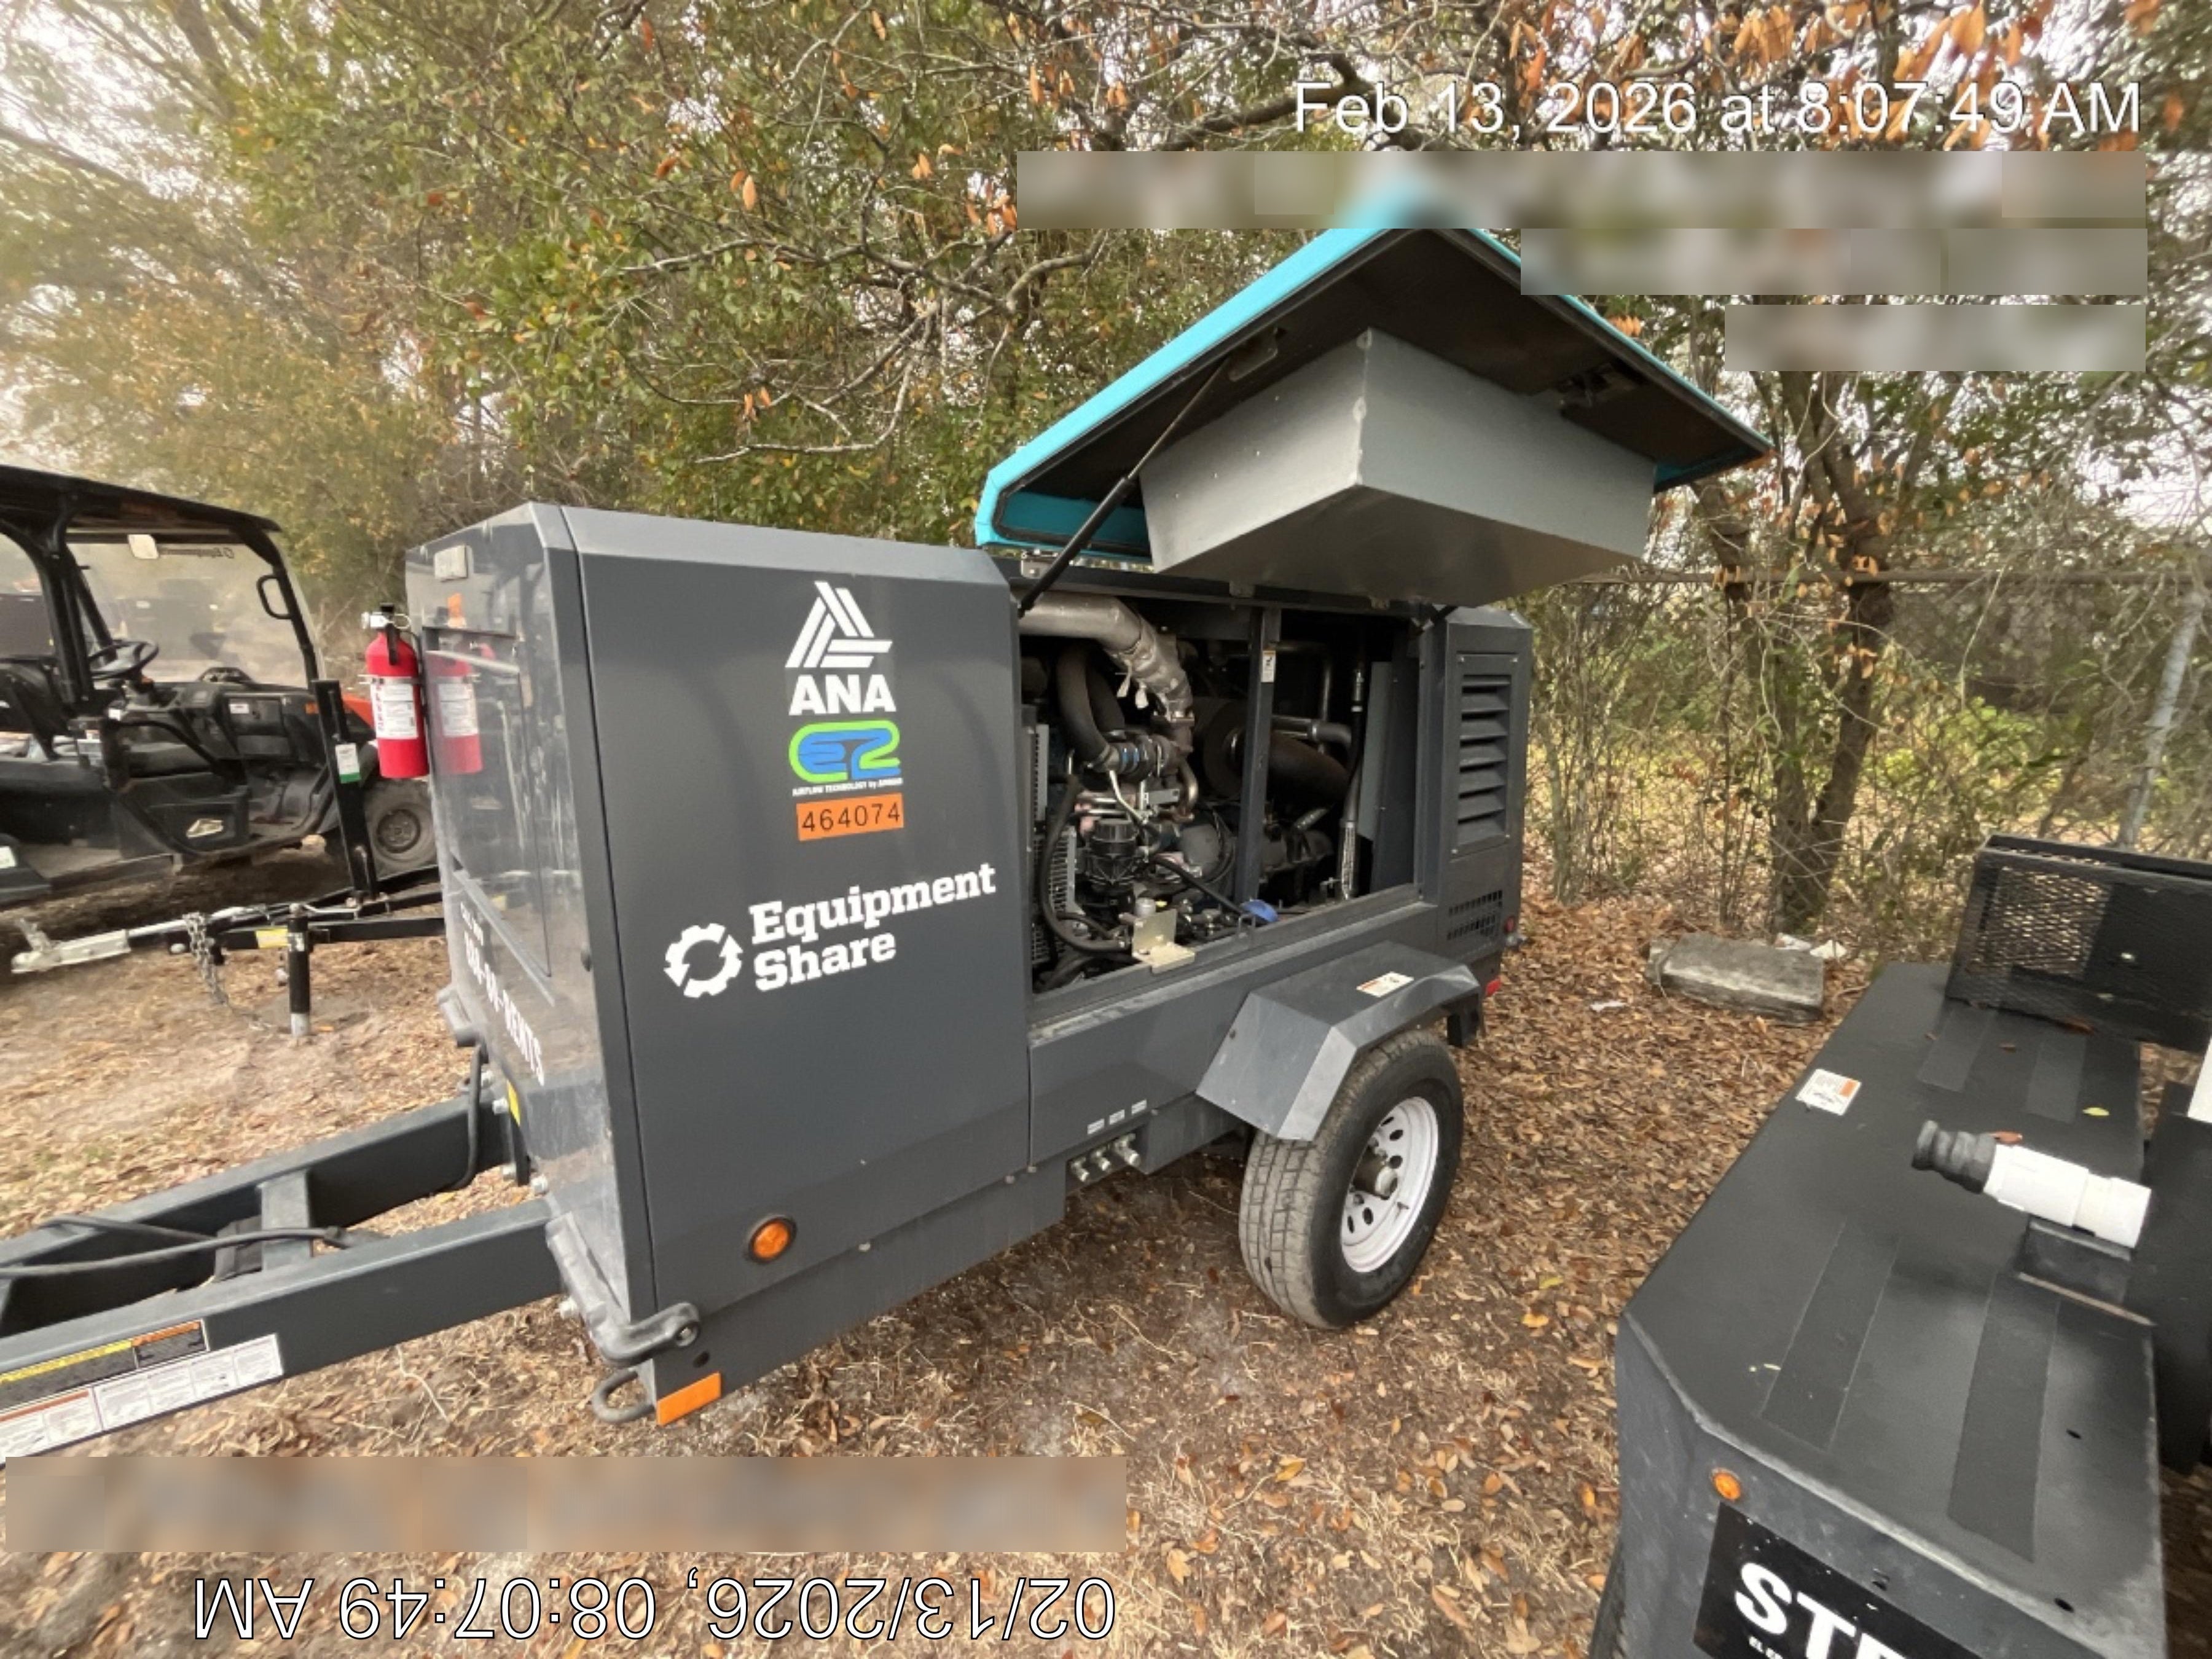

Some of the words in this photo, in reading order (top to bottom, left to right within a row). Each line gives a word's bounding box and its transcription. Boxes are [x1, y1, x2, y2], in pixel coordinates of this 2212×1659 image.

[789, 674, 896, 715] ANA
[801, 802, 900, 832] 464074
[748, 863, 997, 945] Equipment
[753, 932, 897, 992] Share
